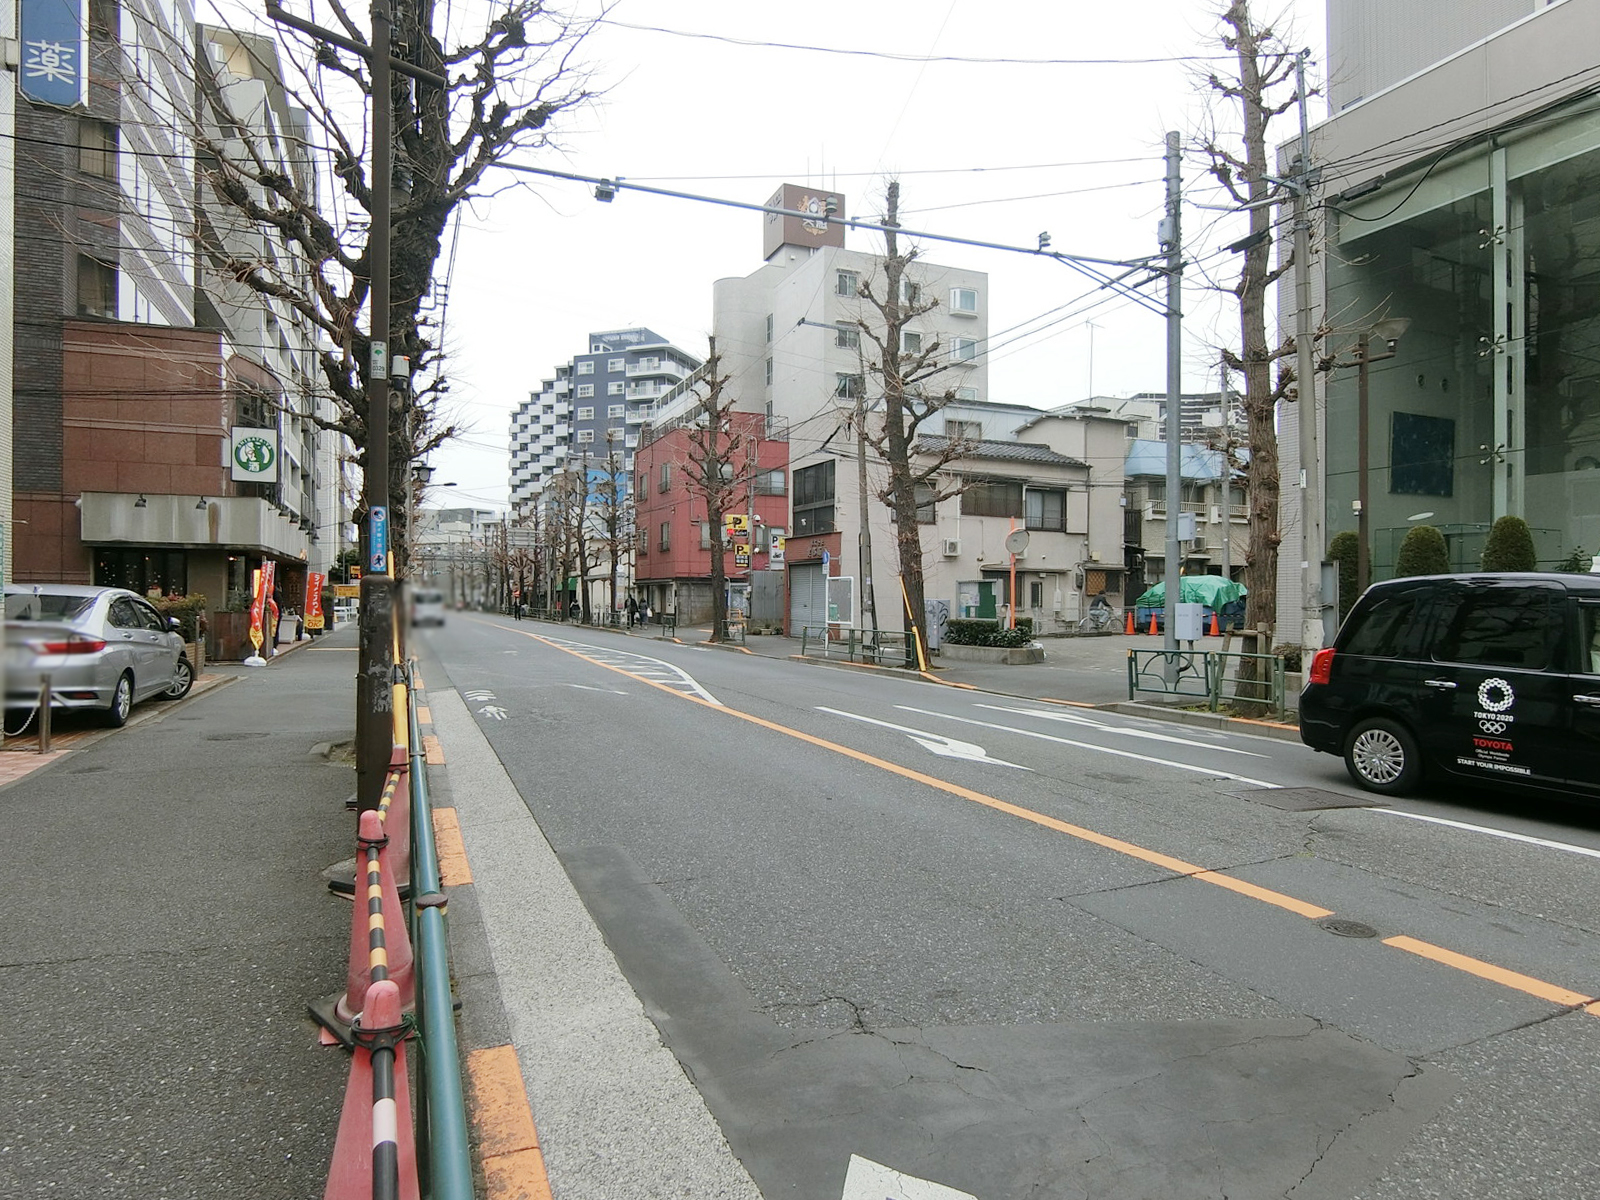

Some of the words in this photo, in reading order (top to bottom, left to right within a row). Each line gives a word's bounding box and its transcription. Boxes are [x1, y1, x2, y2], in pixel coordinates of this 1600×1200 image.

[25, 39, 75, 84] 薬
[732, 516, 743, 528] P
[772, 536, 778, 544] P
[736, 545, 744, 554] P
[1473, 711, 1496, 720] TOKYO
[1496, 714, 1514, 722] 2020
[1473, 738, 1514, 751] TOYOTA
[1457, 758, 1475, 766] START
[1476, 761, 1493, 769] YOUR
[1494, 764, 1531, 776] IMPOSSIBLE
